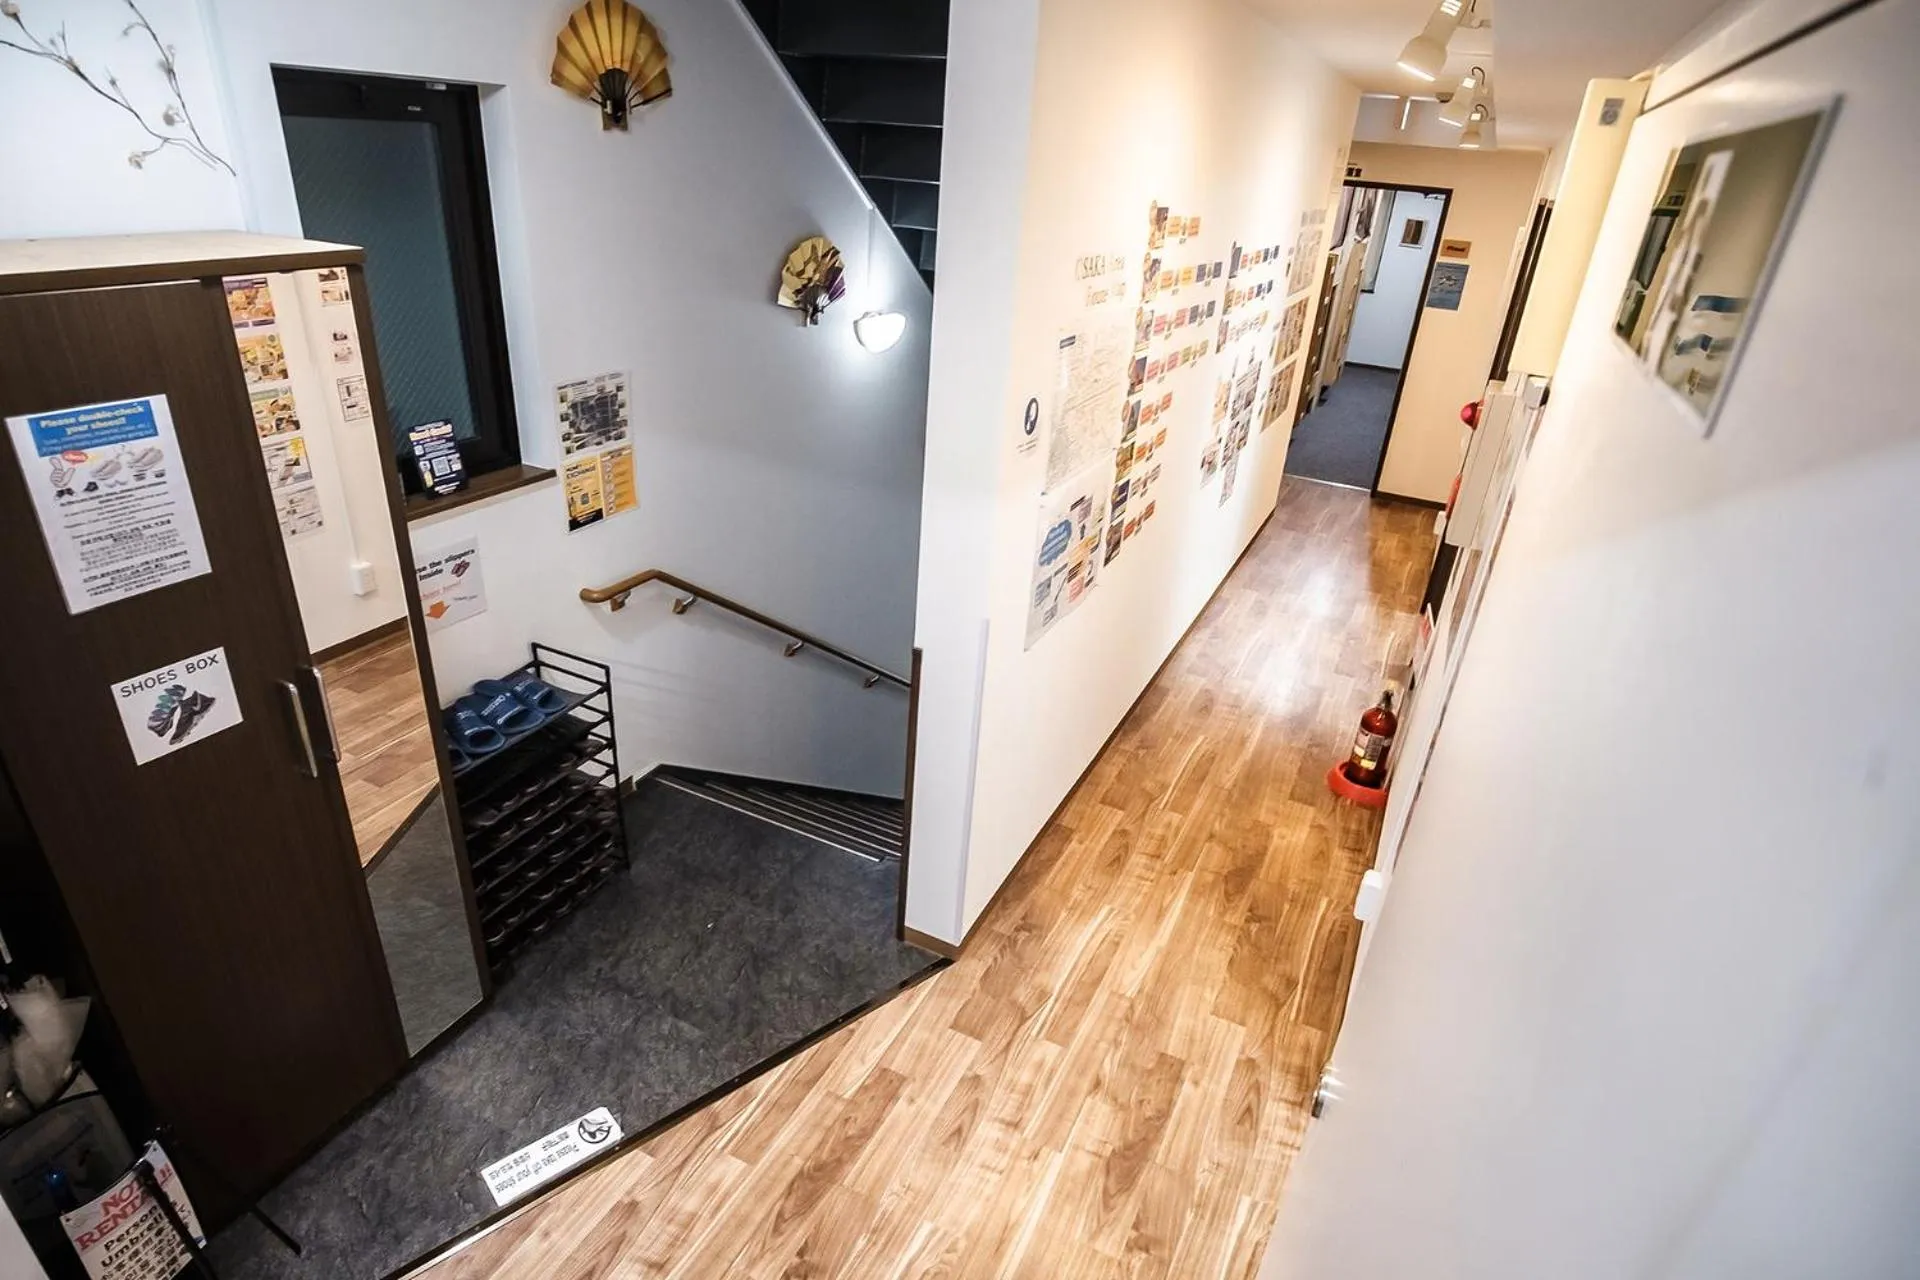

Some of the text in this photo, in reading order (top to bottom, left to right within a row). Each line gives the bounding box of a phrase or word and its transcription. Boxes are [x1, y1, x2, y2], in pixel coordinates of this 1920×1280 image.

[40, 417, 77, 429] Please
[120, 653, 220, 698] SHOES BOX
